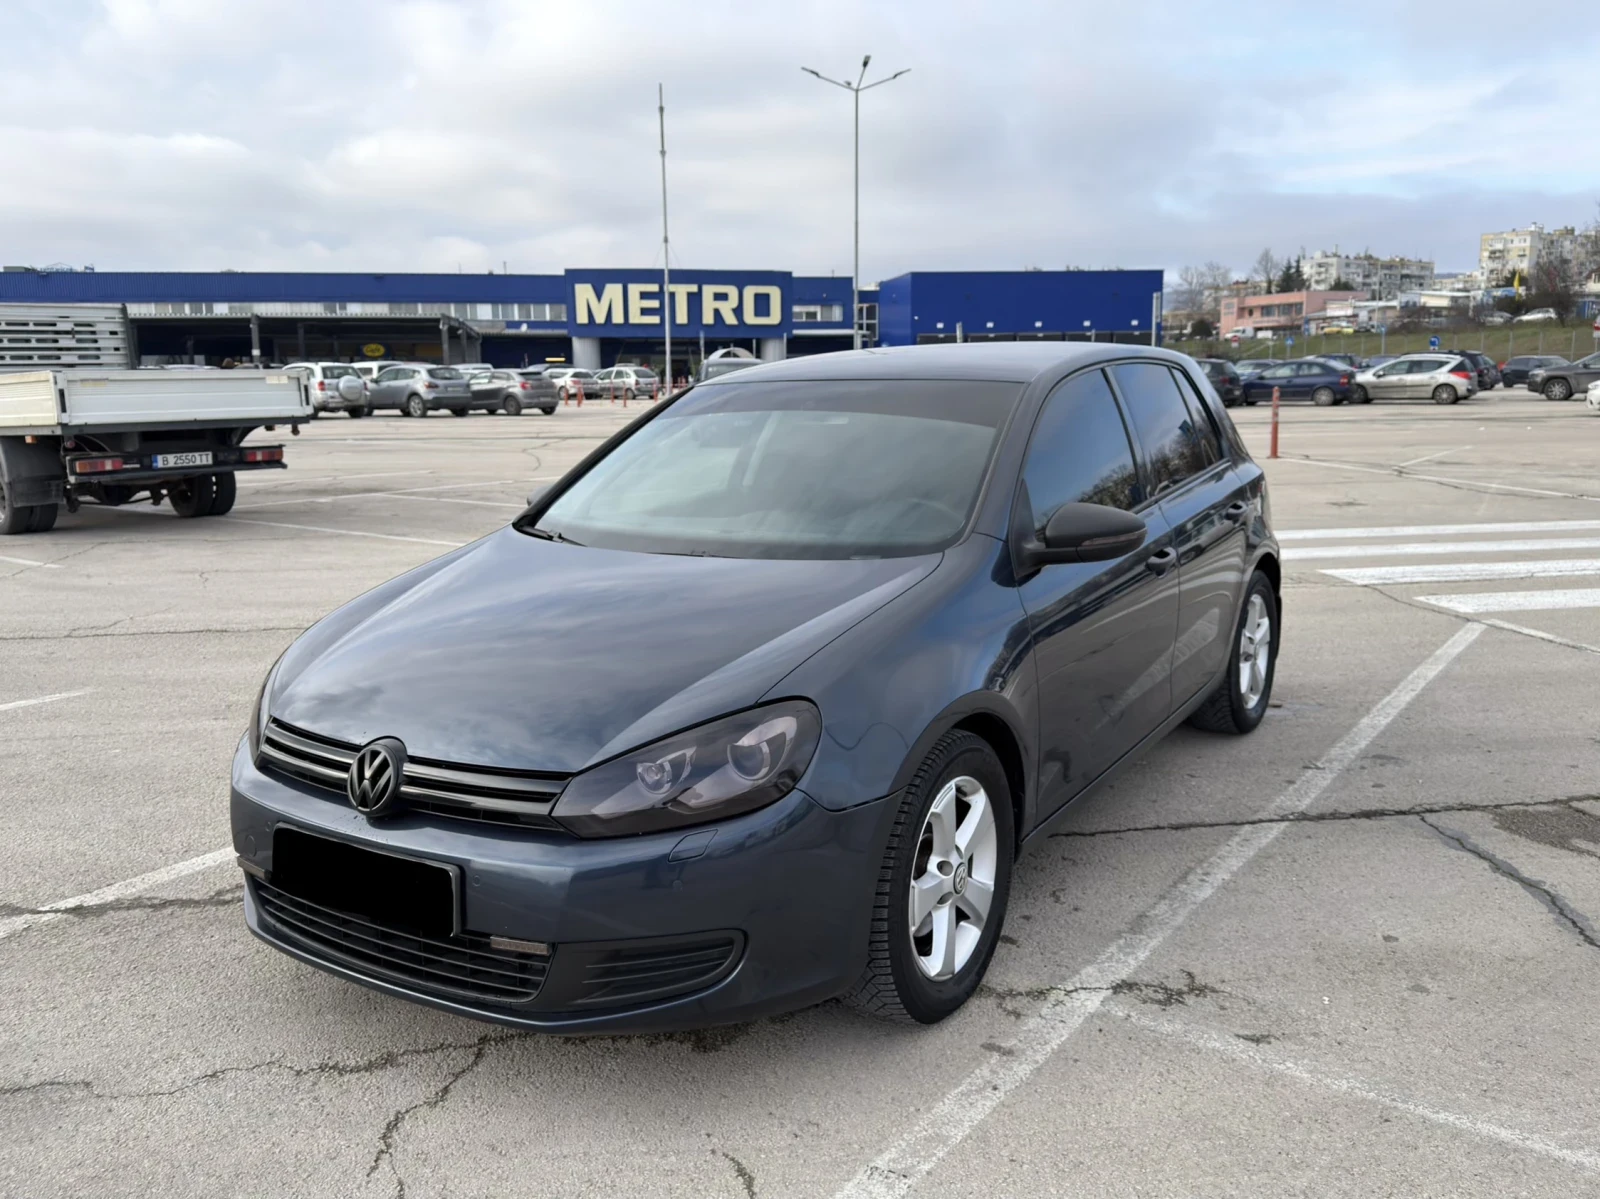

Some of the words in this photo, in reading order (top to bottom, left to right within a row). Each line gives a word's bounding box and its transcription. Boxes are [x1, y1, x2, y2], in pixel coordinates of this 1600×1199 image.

[574, 283, 782, 326] METRO
[163, 456, 169, 466] B
[174, 455, 196, 466] 2550
[198, 453, 210, 464] TT
